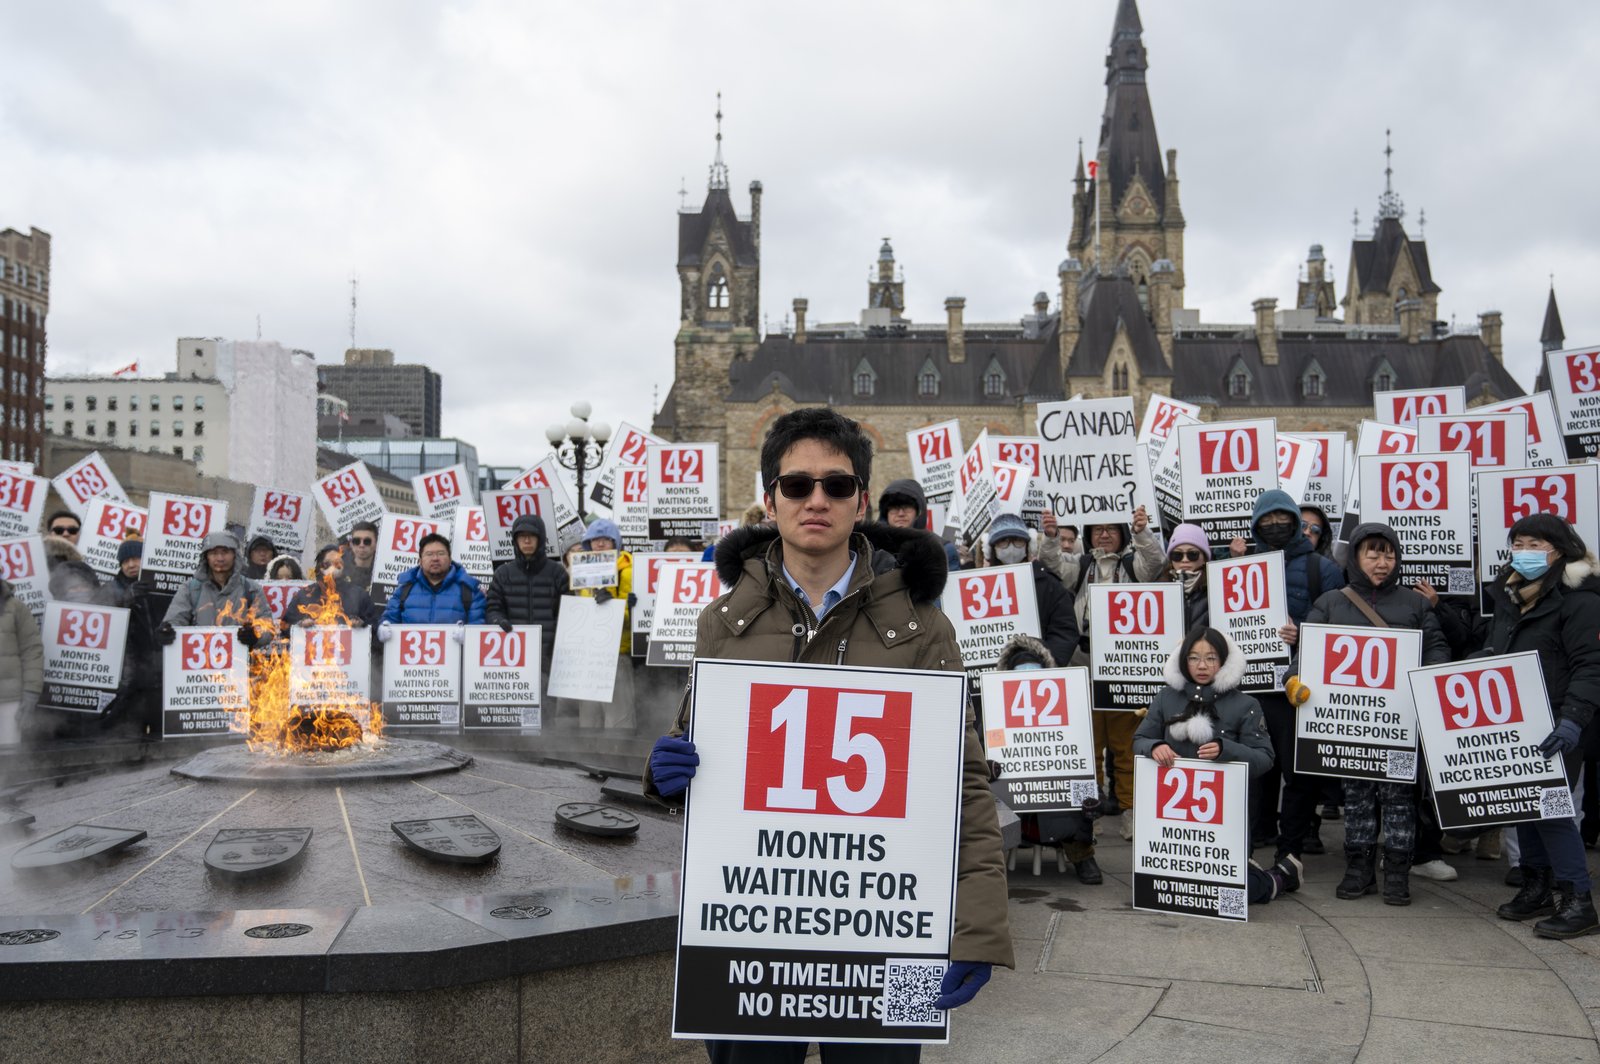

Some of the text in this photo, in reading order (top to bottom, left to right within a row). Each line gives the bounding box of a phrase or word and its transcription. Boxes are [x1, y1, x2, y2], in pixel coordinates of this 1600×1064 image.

[1041, 410, 1137, 443] CANADA
[1566, 419, 1589, 432] IRCC
[921, 430, 945, 463] 27
[1447, 422, 1498, 465] 21
[1579, 436, 1593, 446] NO
[1205, 428, 1252, 473] 70
[665, 450, 699, 482] 42
[926, 463, 951, 475] MONTHS
[1043, 454, 1134, 483] WHAT ARE
[71, 465, 104, 502] 68
[428, 473, 456, 502] 19
[1153, 474, 1171, 487] IRCC
[1206, 476, 1252, 488] MONTHS
[1389, 462, 1441, 510] 68
[325, 471, 363, 505] 39
[666, 487, 699, 495] MONTHS
[1028, 490, 1043, 498] FOR
[657, 497, 708, 505] WAITING FOR
[1047, 481, 1137, 516] YOU DOING?
[1195, 489, 1241, 502] WAITING
[1315, 494, 1332, 503] FOR
[1513, 475, 1568, 521] 53
[266, 492, 300, 522] 25
[434, 500, 460, 511] MONTHS
[653, 507, 713, 515] IRCC RESPONSE
[1190, 503, 1213, 514] IRCC
[168, 501, 206, 538] 39
[620, 515, 647, 524] WAITING
[1201, 522, 1214, 530] NO
[1389, 515, 1441, 527] MONTHS
[1205, 531, 1218, 540] NO
[1431, 529, 1455, 541] FOR
[495, 549, 513, 557] IRCC
[147, 558, 167, 568] IRCC
[378, 572, 396, 580] IRCC
[679, 569, 714, 604] 51
[1226, 563, 1265, 612] 30
[966, 575, 1012, 618] 34
[1114, 591, 1160, 635] 30
[63, 610, 105, 648] 39
[970, 620, 1014, 636] MONTHS
[1229, 614, 1266, 630] MONTHS
[657, 629, 676, 637] IRCC
[1260, 627, 1277, 640] FOR
[404, 631, 441, 664] 35
[484, 632, 521, 666] 20
[960, 634, 1004, 650] WAITING
[1115, 640, 1159, 650] MONTHS
[61, 650, 101, 661] MONTHS
[186, 634, 228, 669] 36
[665, 653, 675, 661] NO
[1104, 653, 1148, 663] WAITING
[49, 659, 110, 673] WAITING FOR
[1330, 634, 1388, 688] 20
[1098, 666, 1121, 676] IRCC
[64, 672, 115, 685] RESPONSE
[186, 674, 226, 683] MONTHS
[394, 680, 449, 688] WAITING FOR
[49, 686, 61, 694] NO
[176, 685, 237, 694] WAITING FOR
[474, 682, 529, 690] WAITING FOR
[1109, 685, 1121, 693] NO
[51, 695, 63, 703] NO
[170, 696, 191, 705] IRCC
[389, 690, 454, 698] IRCC RESPONSE
[469, 692, 534, 700] IRCC RESPONSE
[1113, 695, 1125, 704] NO
[1329, 693, 1387, 707] MONTHS
[1445, 669, 1512, 728] 90
[1010, 679, 1062, 726] 42
[180, 712, 190, 720] NO
[1314, 707, 1401, 724] WAITING FOR
[183, 721, 194, 729] NO
[1305, 721, 1409, 740] IRCC RESPONSE
[1013, 731, 1064, 744] MONTHS
[1456, 729, 1520, 749] MONTHS
[766, 688, 886, 814] 15
[1001, 744, 1078, 759] WAITING FOR
[1317, 744, 1386, 759] NO TIMELINE
[1444, 743, 1541, 767] WAITING FOR
[1023, 758, 1086, 772] RESPONSE
[1322, 757, 1387, 772] NO RESULTS
[1439, 758, 1554, 784] IRCC RESPONSE
[1008, 782, 1022, 792] NO
[1013, 791, 1072, 804] NO RESULTS
[1162, 766, 1217, 823] 25
[1458, 792, 1477, 804] NO
[1467, 799, 1540, 817] NO RESULTS
[1163, 826, 1216, 843] MONTHS
[757, 829, 886, 861] MONTHS
[1149, 841, 1230, 860] WAITING FOR
[1142, 855, 1237, 877] IRCC RESPONSE
[721, 866, 918, 901] WAITING FOR
[1153, 879, 1218, 896] NO TIMELINE
[1158, 892, 1218, 910] NO RESULTS
[700, 903, 934, 939] IRCC RESPONSE
[91, 929, 207, 940] 1873
[728, 960, 885, 988] NO TIMELINE
[738, 991, 774, 1017] NO
